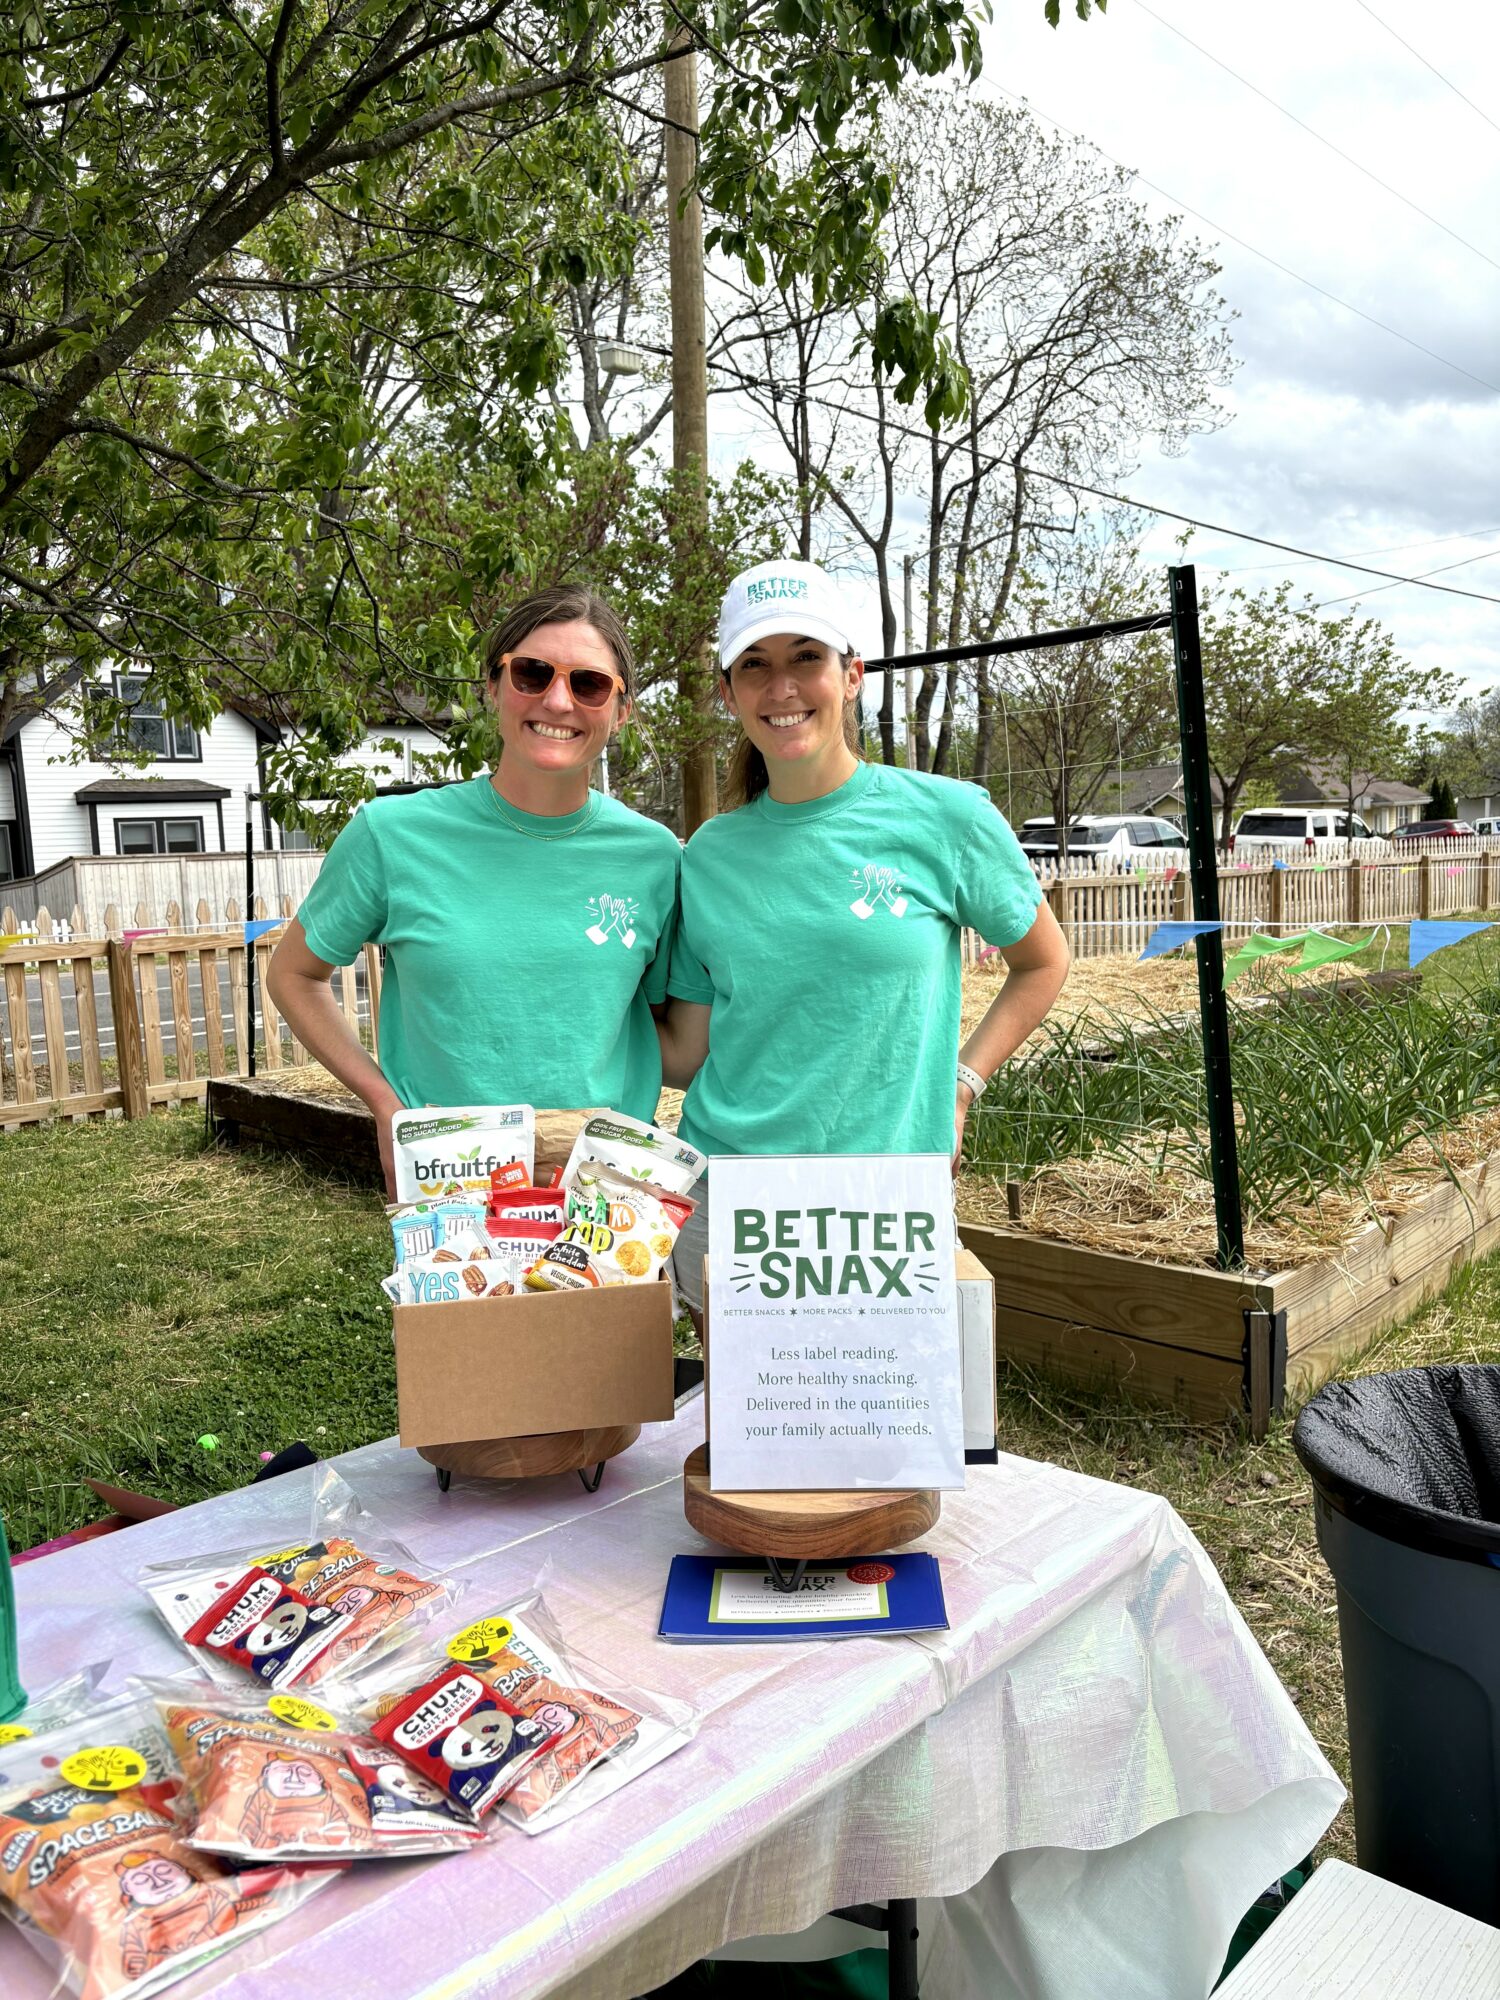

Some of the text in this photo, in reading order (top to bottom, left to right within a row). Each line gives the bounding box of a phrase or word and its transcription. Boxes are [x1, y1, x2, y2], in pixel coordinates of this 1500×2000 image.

[747, 576, 808, 597] BETTER
[754, 589, 800, 604] SNAX
[413, 1129, 437, 1137] SUGAR
[438, 1123, 462, 1132] ADDED
[419, 1121, 439, 1131] FRUIT
[593, 1121, 627, 1134] 100% FRUIT
[599, 1129, 621, 1139] SUGAR
[621, 1135, 644, 1145] ADDED
[414, 1155, 516, 1181] bfruitf
[507, 1209, 557, 1222] CHUM
[733, 1207, 936, 1254] BETTER
[497, 1241, 550, 1253] CHUM
[553, 1244, 581, 1257] White
[549, 1252, 587, 1270] Cheddar
[550, 1268, 568, 1283] VEGGIE
[759, 1251, 912, 1299] SNAX
[723, 1306, 946, 1316] BETTER SNACKS MORE PACKS DELIVERED TO YOU
[771, 1347, 898, 1363] Less label reading.
[757, 1371, 918, 1388] More healthy snacking.
[746, 1397, 930, 1414] Delivered in the quantities
[745, 1422, 932, 1440] your family actually needs.
[212, 1583, 269, 1635] CHUM
[218, 1613, 247, 1641] FRUIT
[248, 1590, 276, 1613] BITES
[508, 1632, 552, 1678] BETTER
[402, 1680, 467, 1735] CHUM
[410, 1688, 474, 1742] FRUIT BITES
[416, 1690, 478, 1744] STRAWBERRY
[197, 1725, 277, 1756] SPACE
[28, 1819, 111, 1889] SPACE
